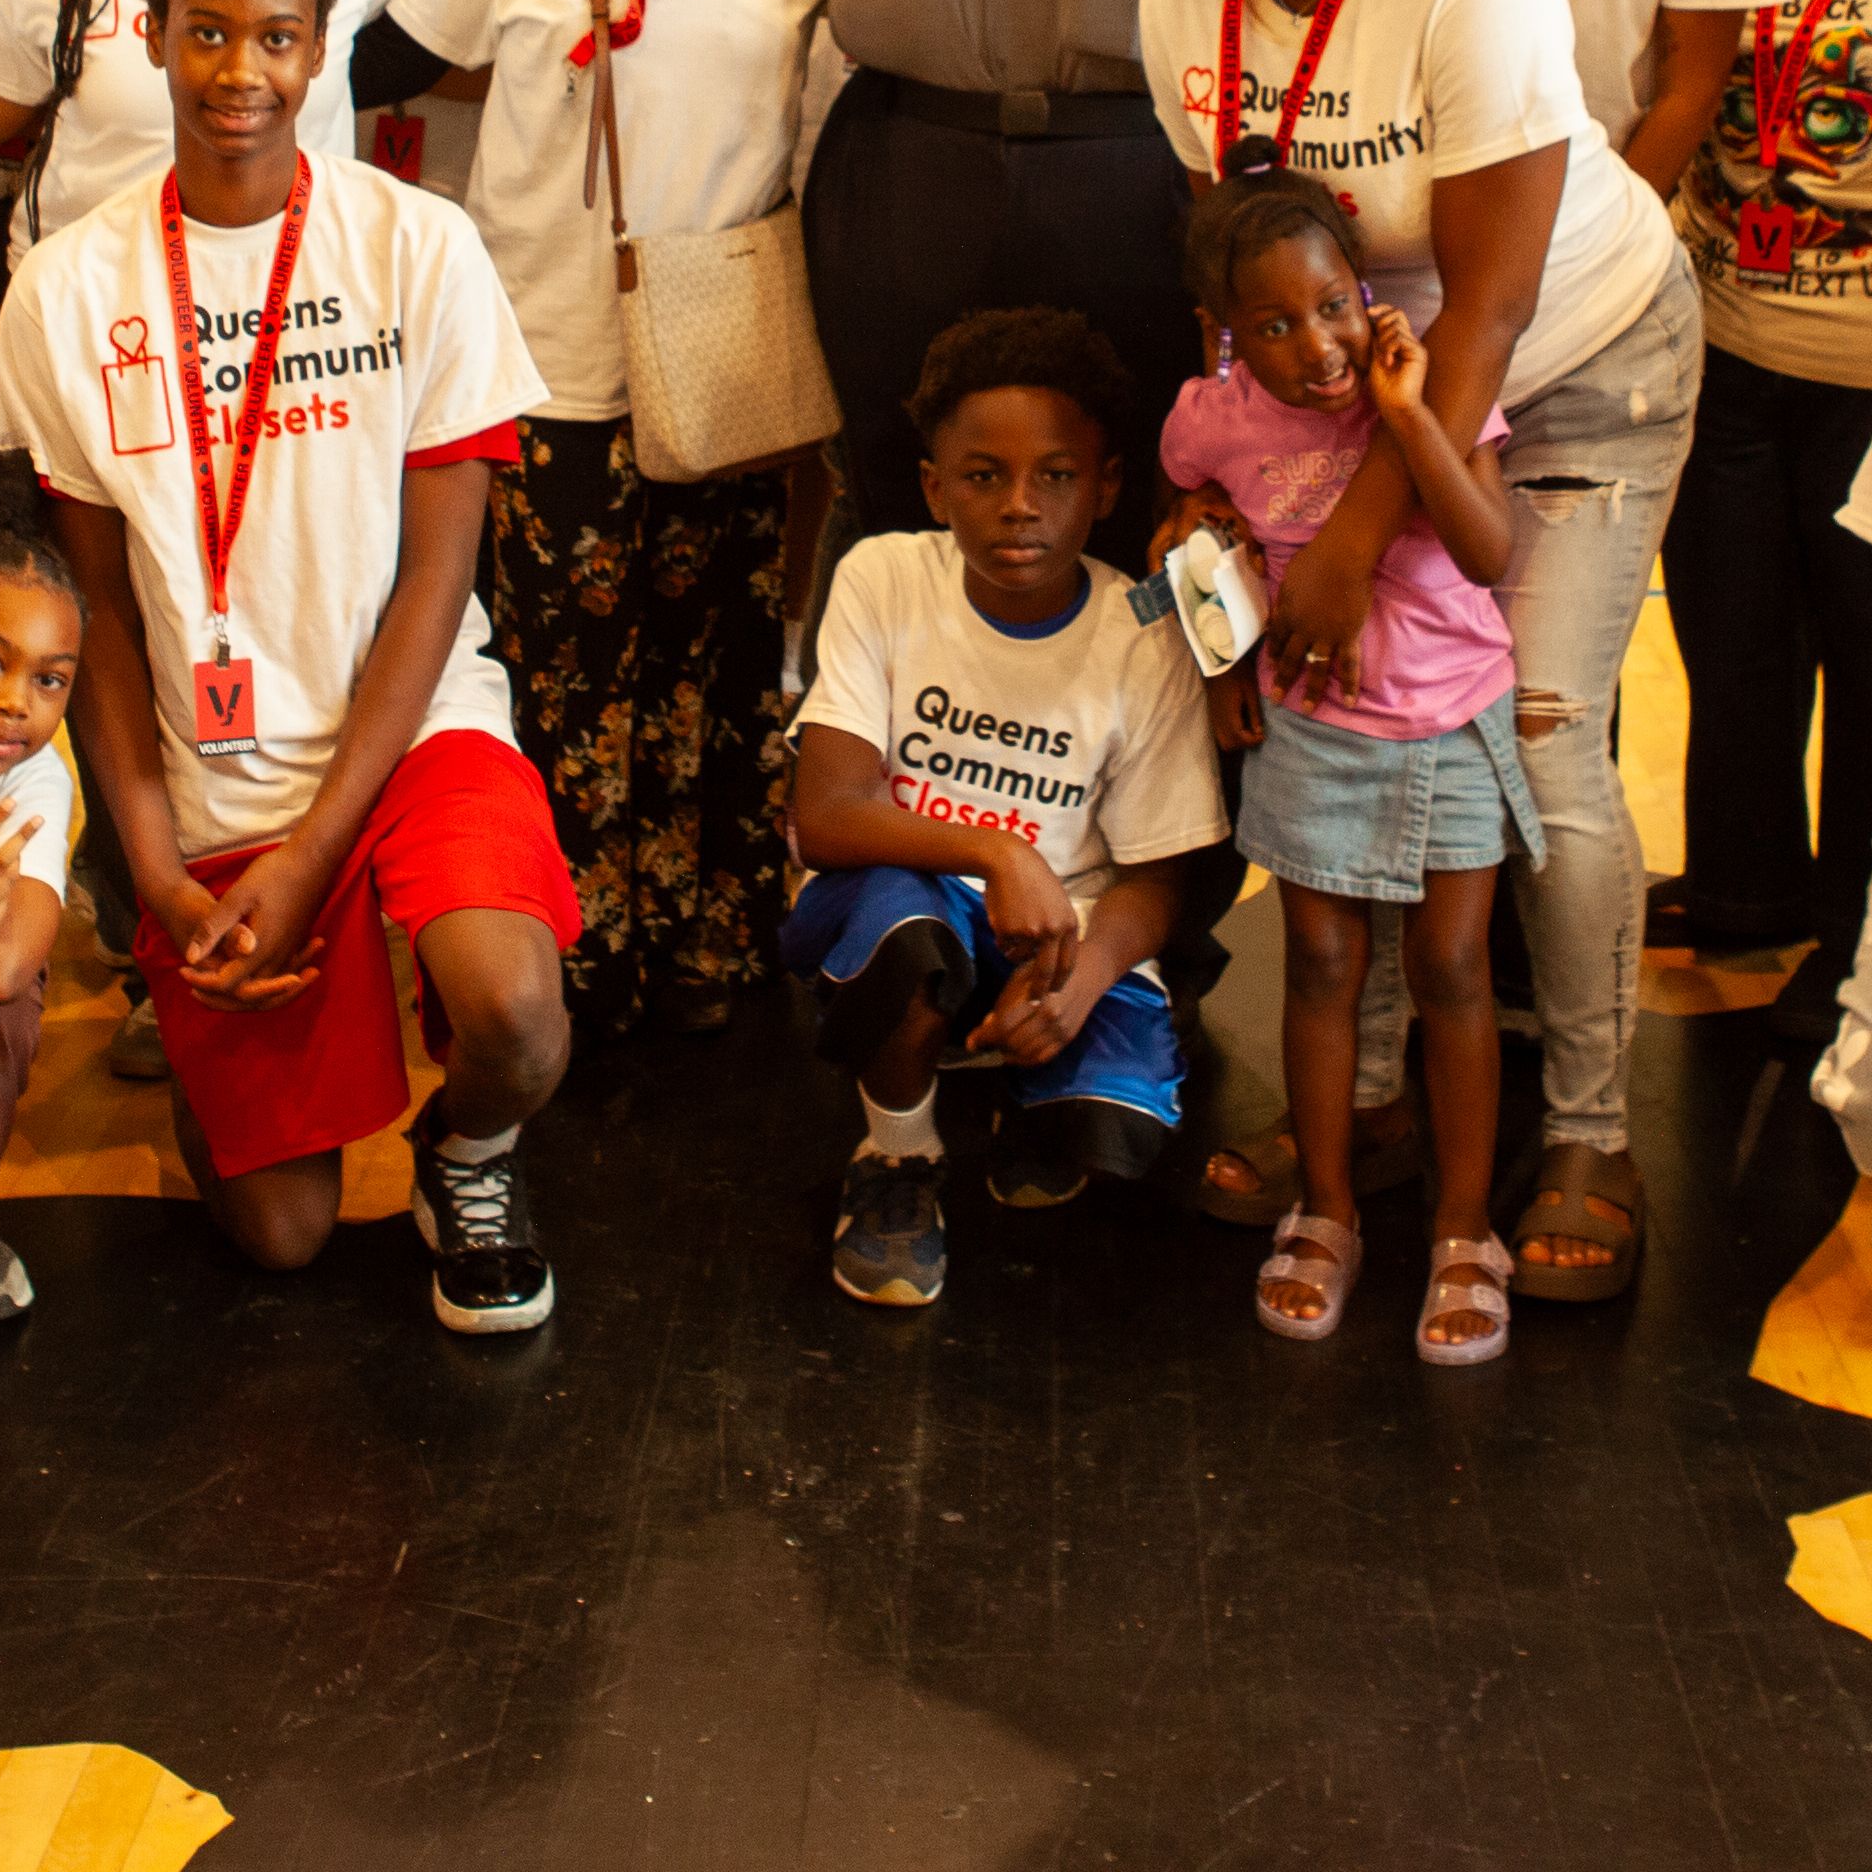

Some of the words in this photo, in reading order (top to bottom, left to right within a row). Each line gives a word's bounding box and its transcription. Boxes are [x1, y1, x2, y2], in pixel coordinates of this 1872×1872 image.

[169, 238, 193, 333] VOLUNTEER
[267, 222, 299, 318] VOLUNTEER
[183, 360, 209, 457] VOLUNTEER
[243, 341, 273, 437] VOLUNTEER
[198, 738, 256, 756] VOLUNTEER
[898, 731, 1090, 808] Commun
[914, 685, 1073, 759] Queens
